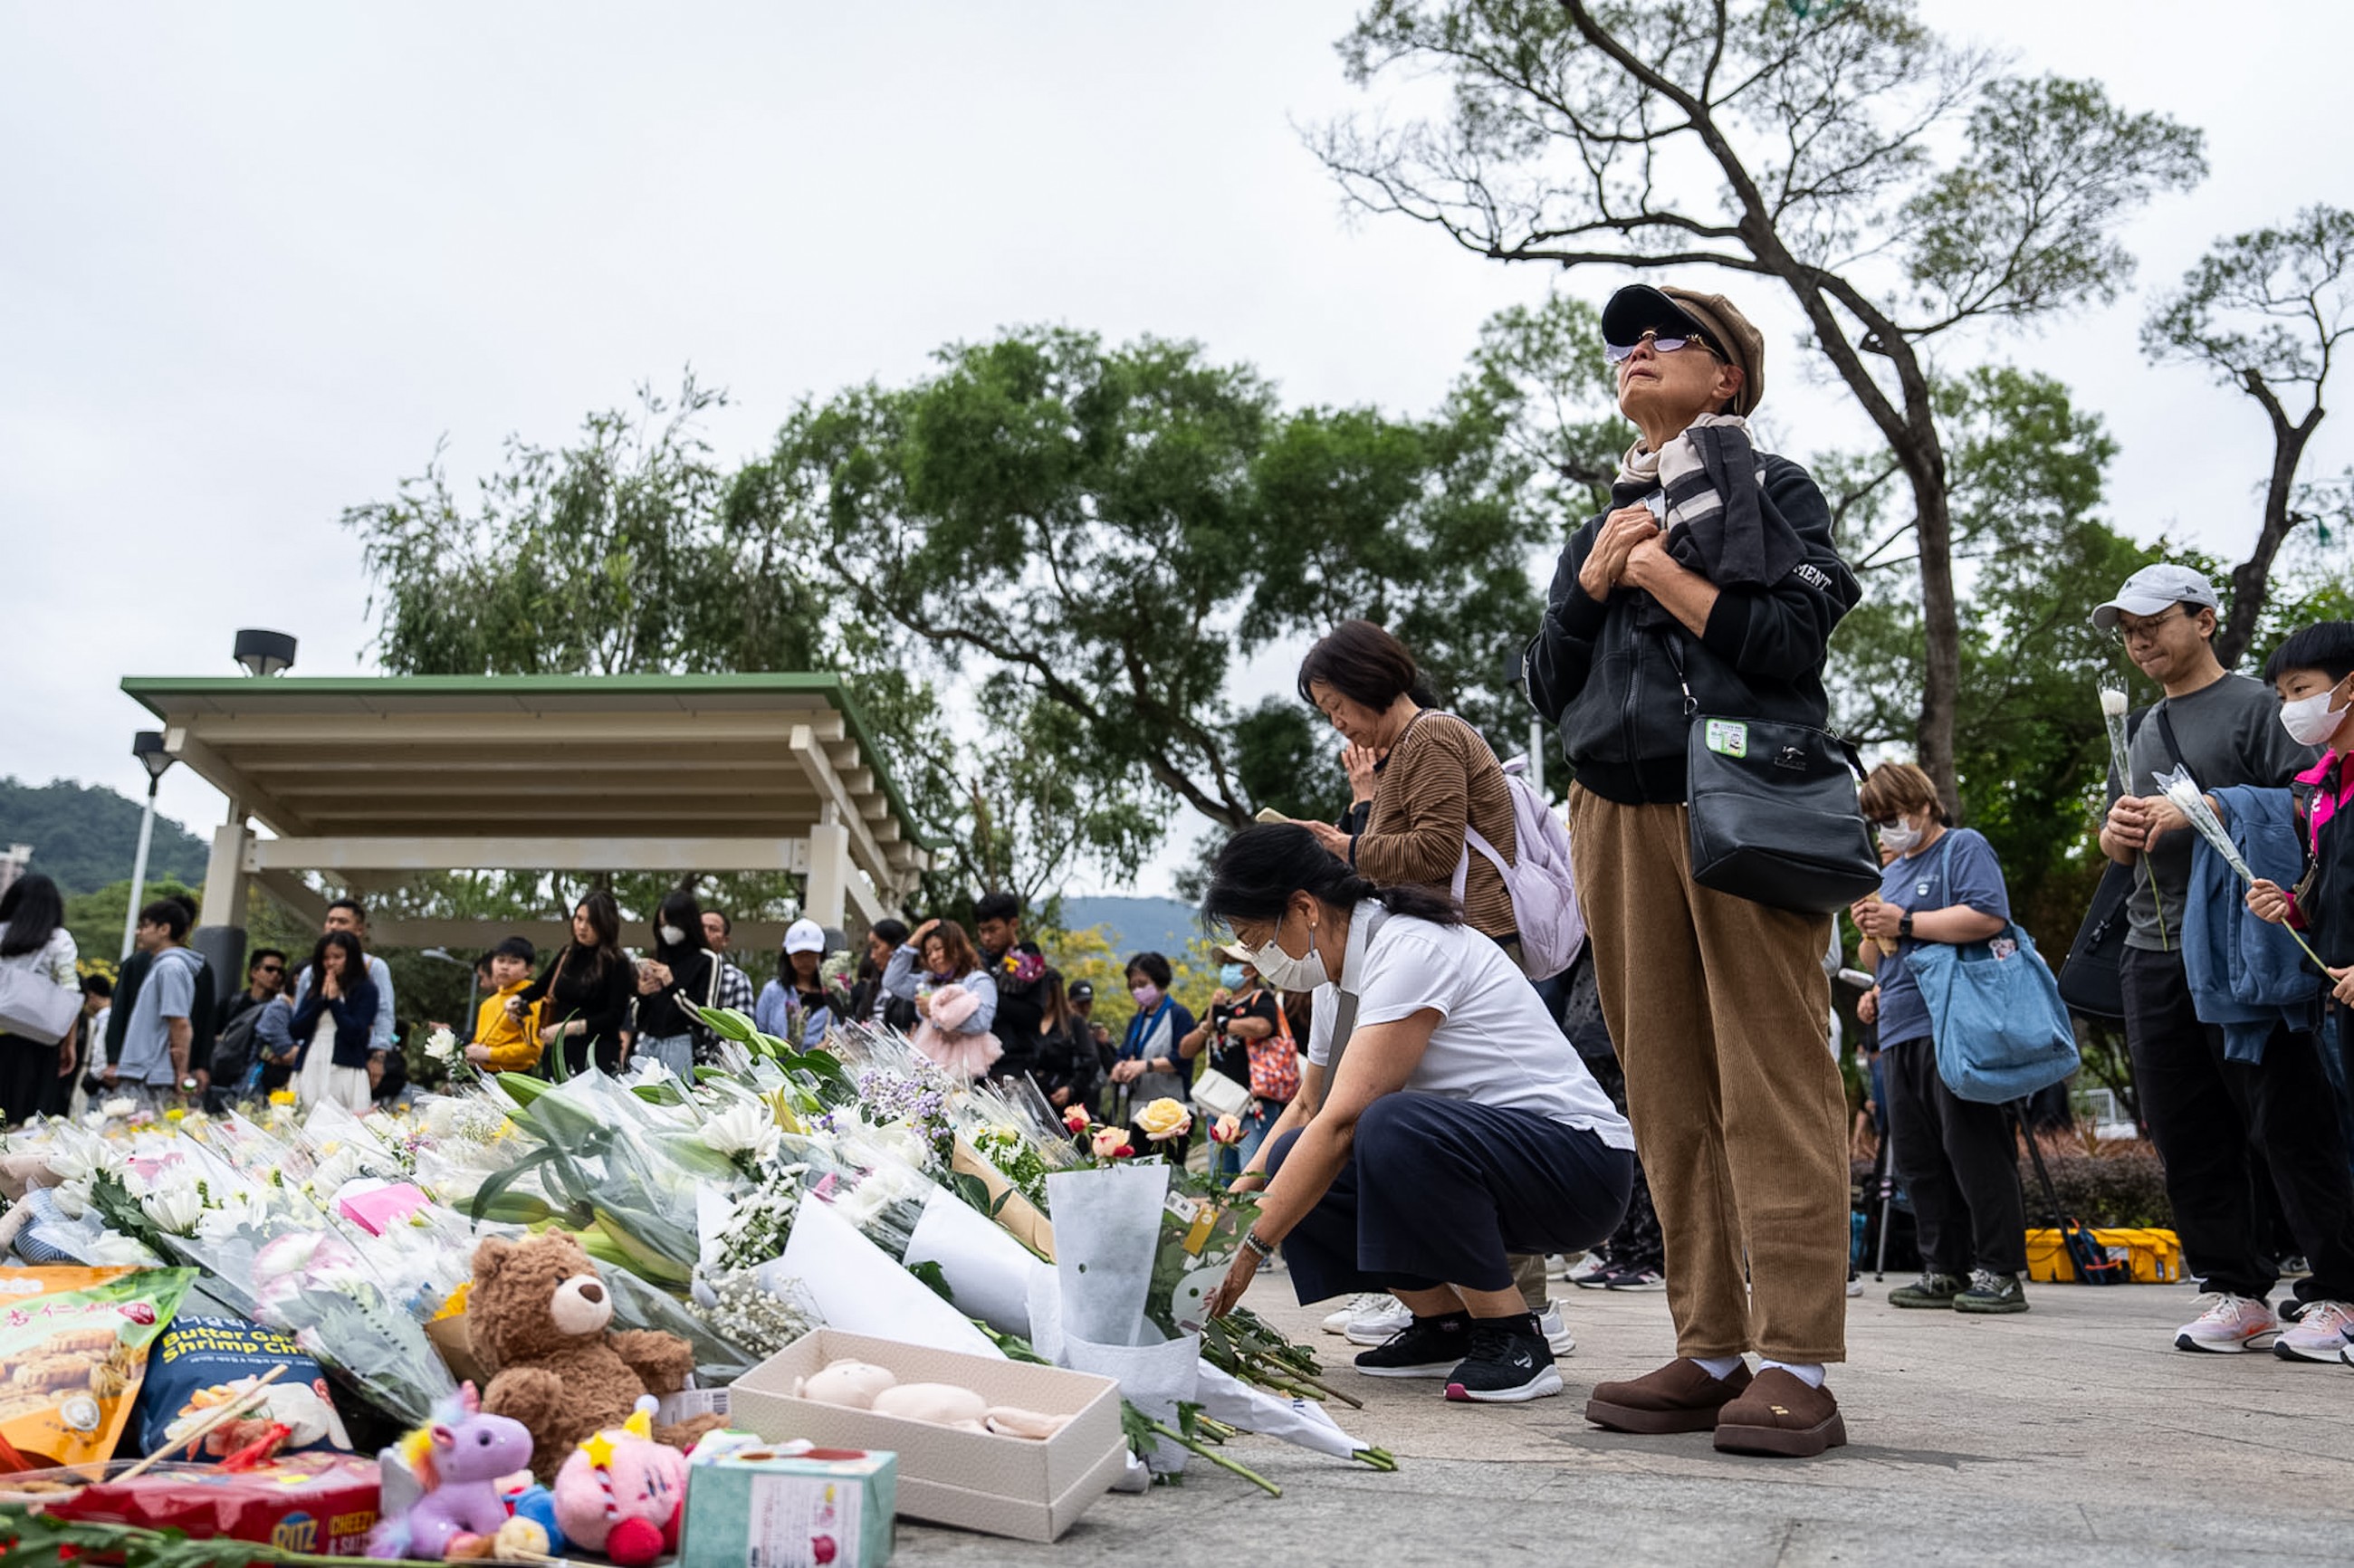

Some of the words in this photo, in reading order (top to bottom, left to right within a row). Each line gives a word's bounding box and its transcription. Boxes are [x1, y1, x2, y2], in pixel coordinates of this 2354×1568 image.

[1793, 563, 1832, 590] MENT
[162, 1326, 244, 1348] Butter
[162, 1337, 260, 1363] Shrimp
[272, 1518, 319, 1551] RITZ
